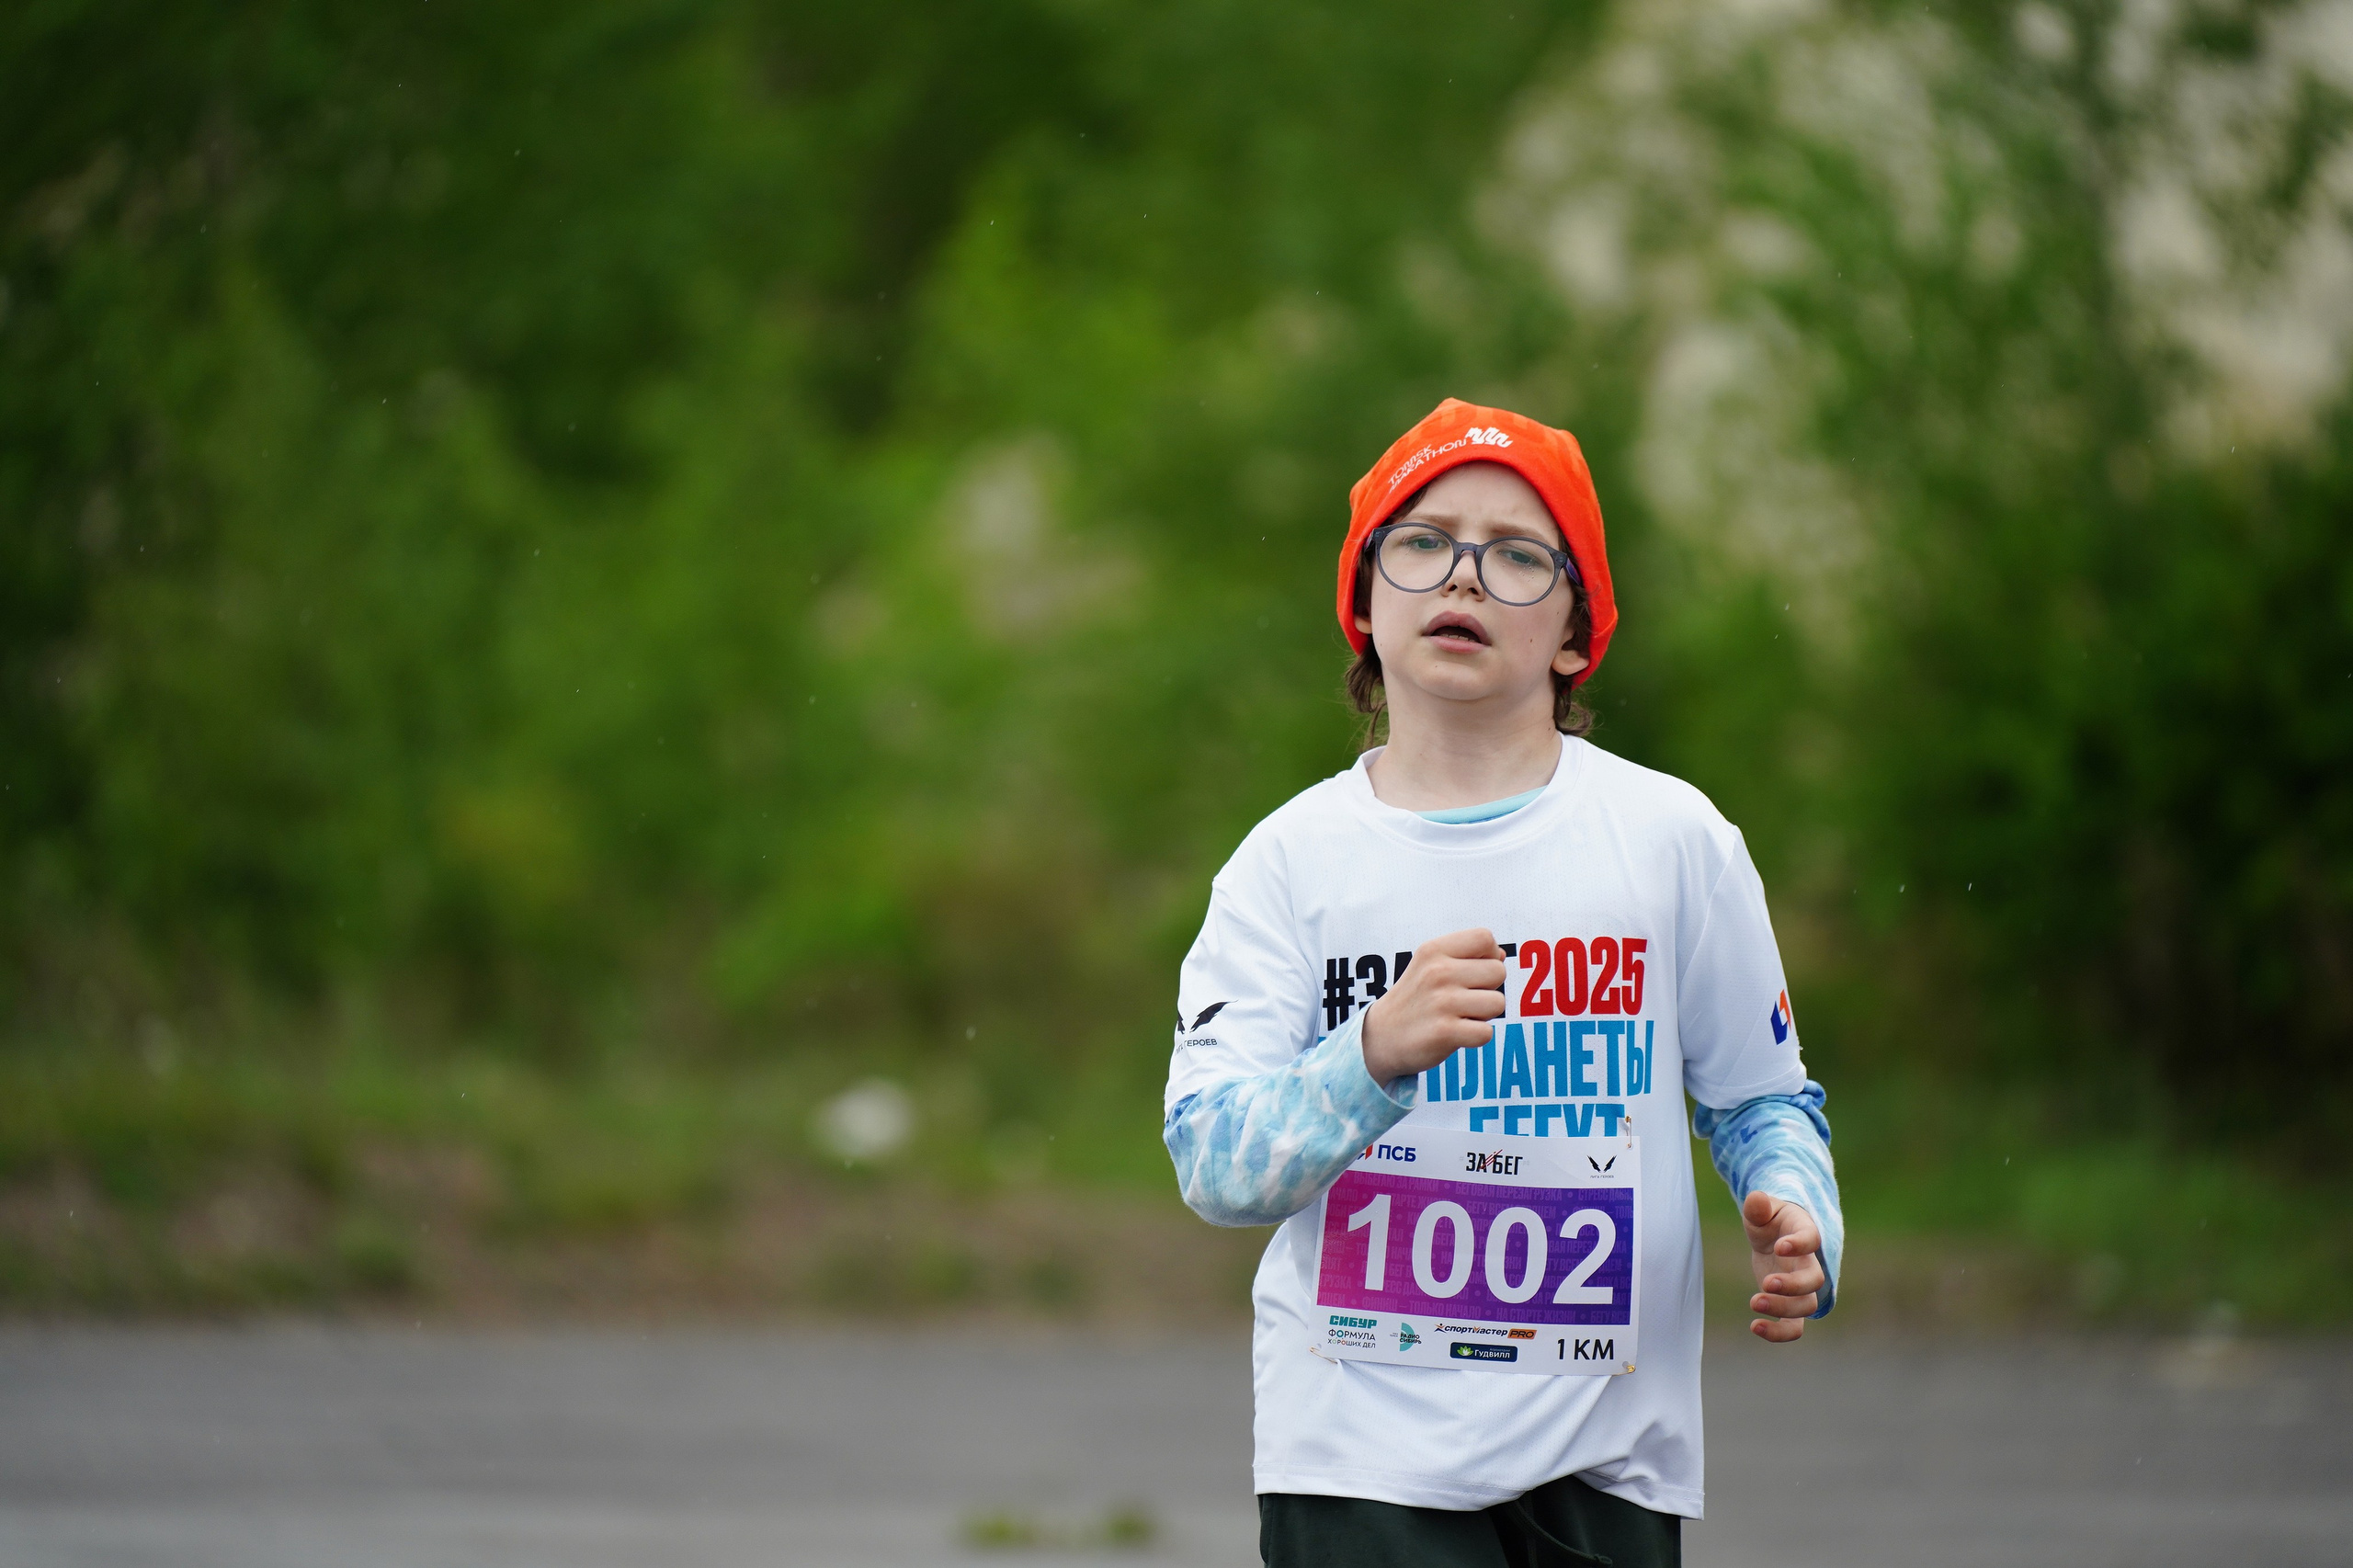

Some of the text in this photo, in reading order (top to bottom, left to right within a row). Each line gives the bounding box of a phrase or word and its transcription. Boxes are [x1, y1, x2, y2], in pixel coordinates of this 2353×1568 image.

[1388, 444, 1431, 484] TOMSK
[1378, 1144, 1416, 1162] ПСБ
[1347, 1194, 1617, 1304] 1002
[1329, 1315, 1377, 1329] СИБУР
[1327, 1337, 1361, 1347] ХОРОШИХ
[1328, 1328, 1376, 1341] ФОРМУЛА
[1509, 1330, 1535, 1338] PRO
[1557, 1339, 1564, 1359] 1
